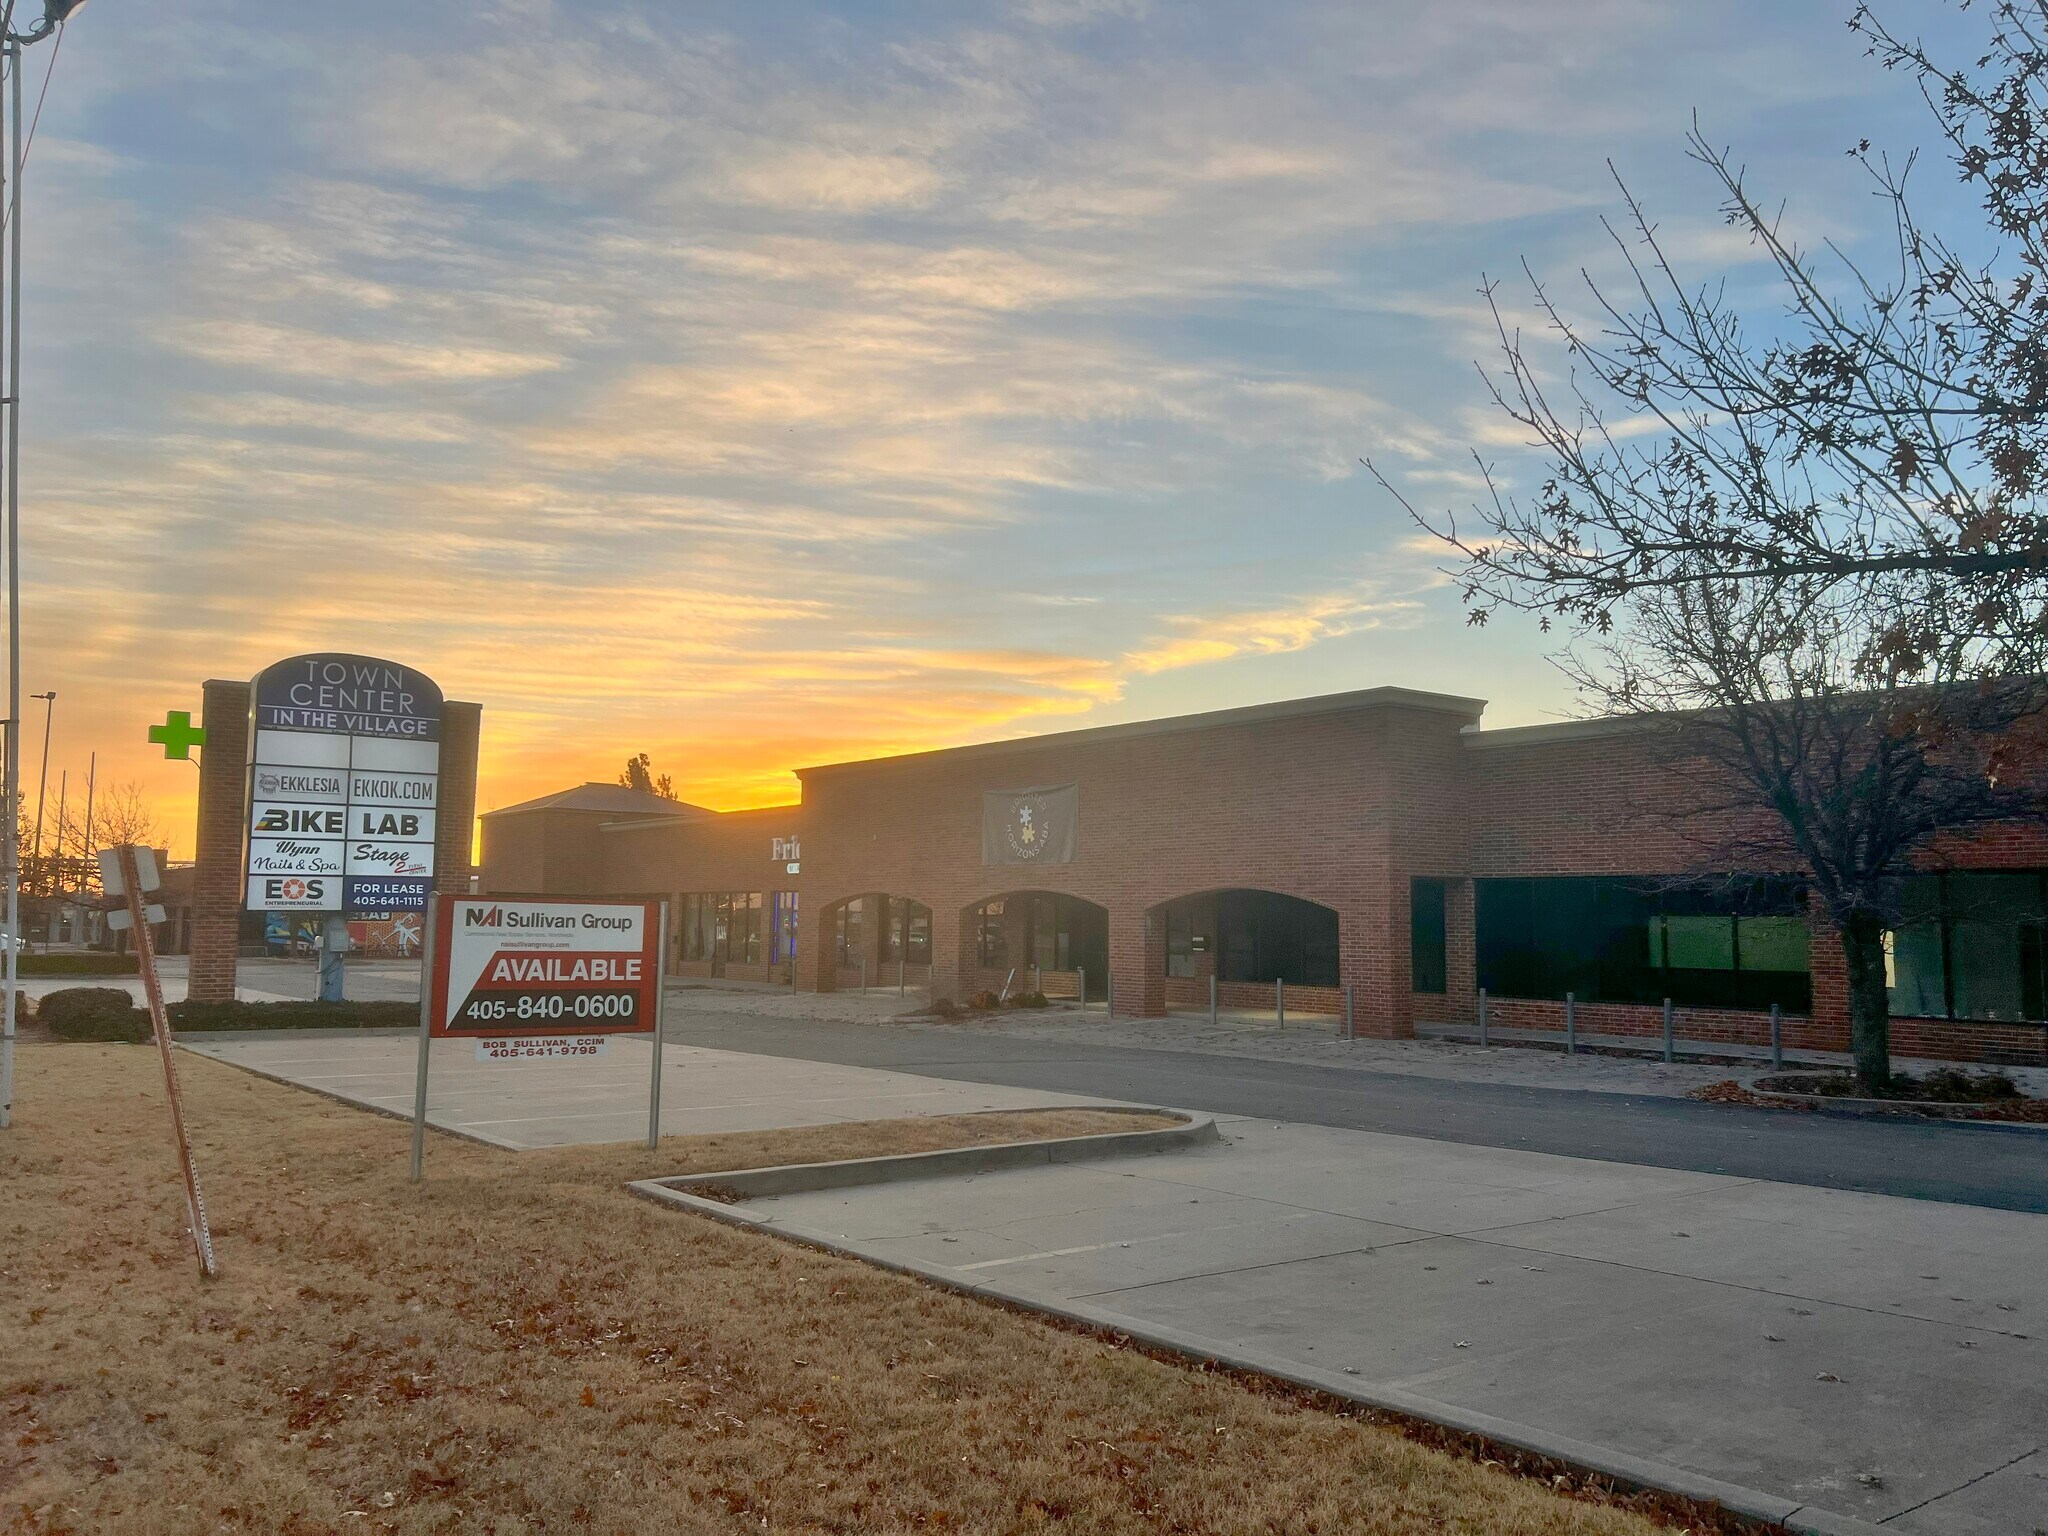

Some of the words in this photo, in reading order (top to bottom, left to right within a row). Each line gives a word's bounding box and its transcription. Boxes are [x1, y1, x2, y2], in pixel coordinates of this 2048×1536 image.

[305, 661, 402, 689] TOWN
[290, 683, 414, 714] CENTER
[273, 709, 294, 725] IN
[301, 711, 337, 728] THE
[344, 714, 427, 735] VILLAGE
[280, 776, 340, 793] EKKLESIA
[354, 779, 433, 800] EKKOK.COM
[254, 809, 343, 833] BIKE
[363, 813, 419, 835] LAB
[276, 841, 321, 857] Wynn
[1007, 824, 1040, 859] HORIZONS
[1040, 821, 1050, 847] ABA
[254, 857, 293, 870] Nails
[295, 860, 306, 870] &
[308, 858, 341, 873] Spa
[353, 844, 410, 866] Stage
[354, 884, 380, 894] FOR
[384, 884, 424, 894] LEASE
[353, 896, 424, 906] 405-641-1115
[466, 905, 502, 927] NAI
[506, 911, 576, 929] Sullivan
[581, 913, 633, 932] Group
[500, 941, 570, 949] naisullivangroup.com
[491, 959, 642, 982] AVAILABLE
[466, 994, 633, 1019] 405-840-0600
[483, 1040, 507, 1048] BOB
[514, 1039, 571, 1048] SULLIVAN,
[489, 1046, 597, 1058] 405-641-9798
